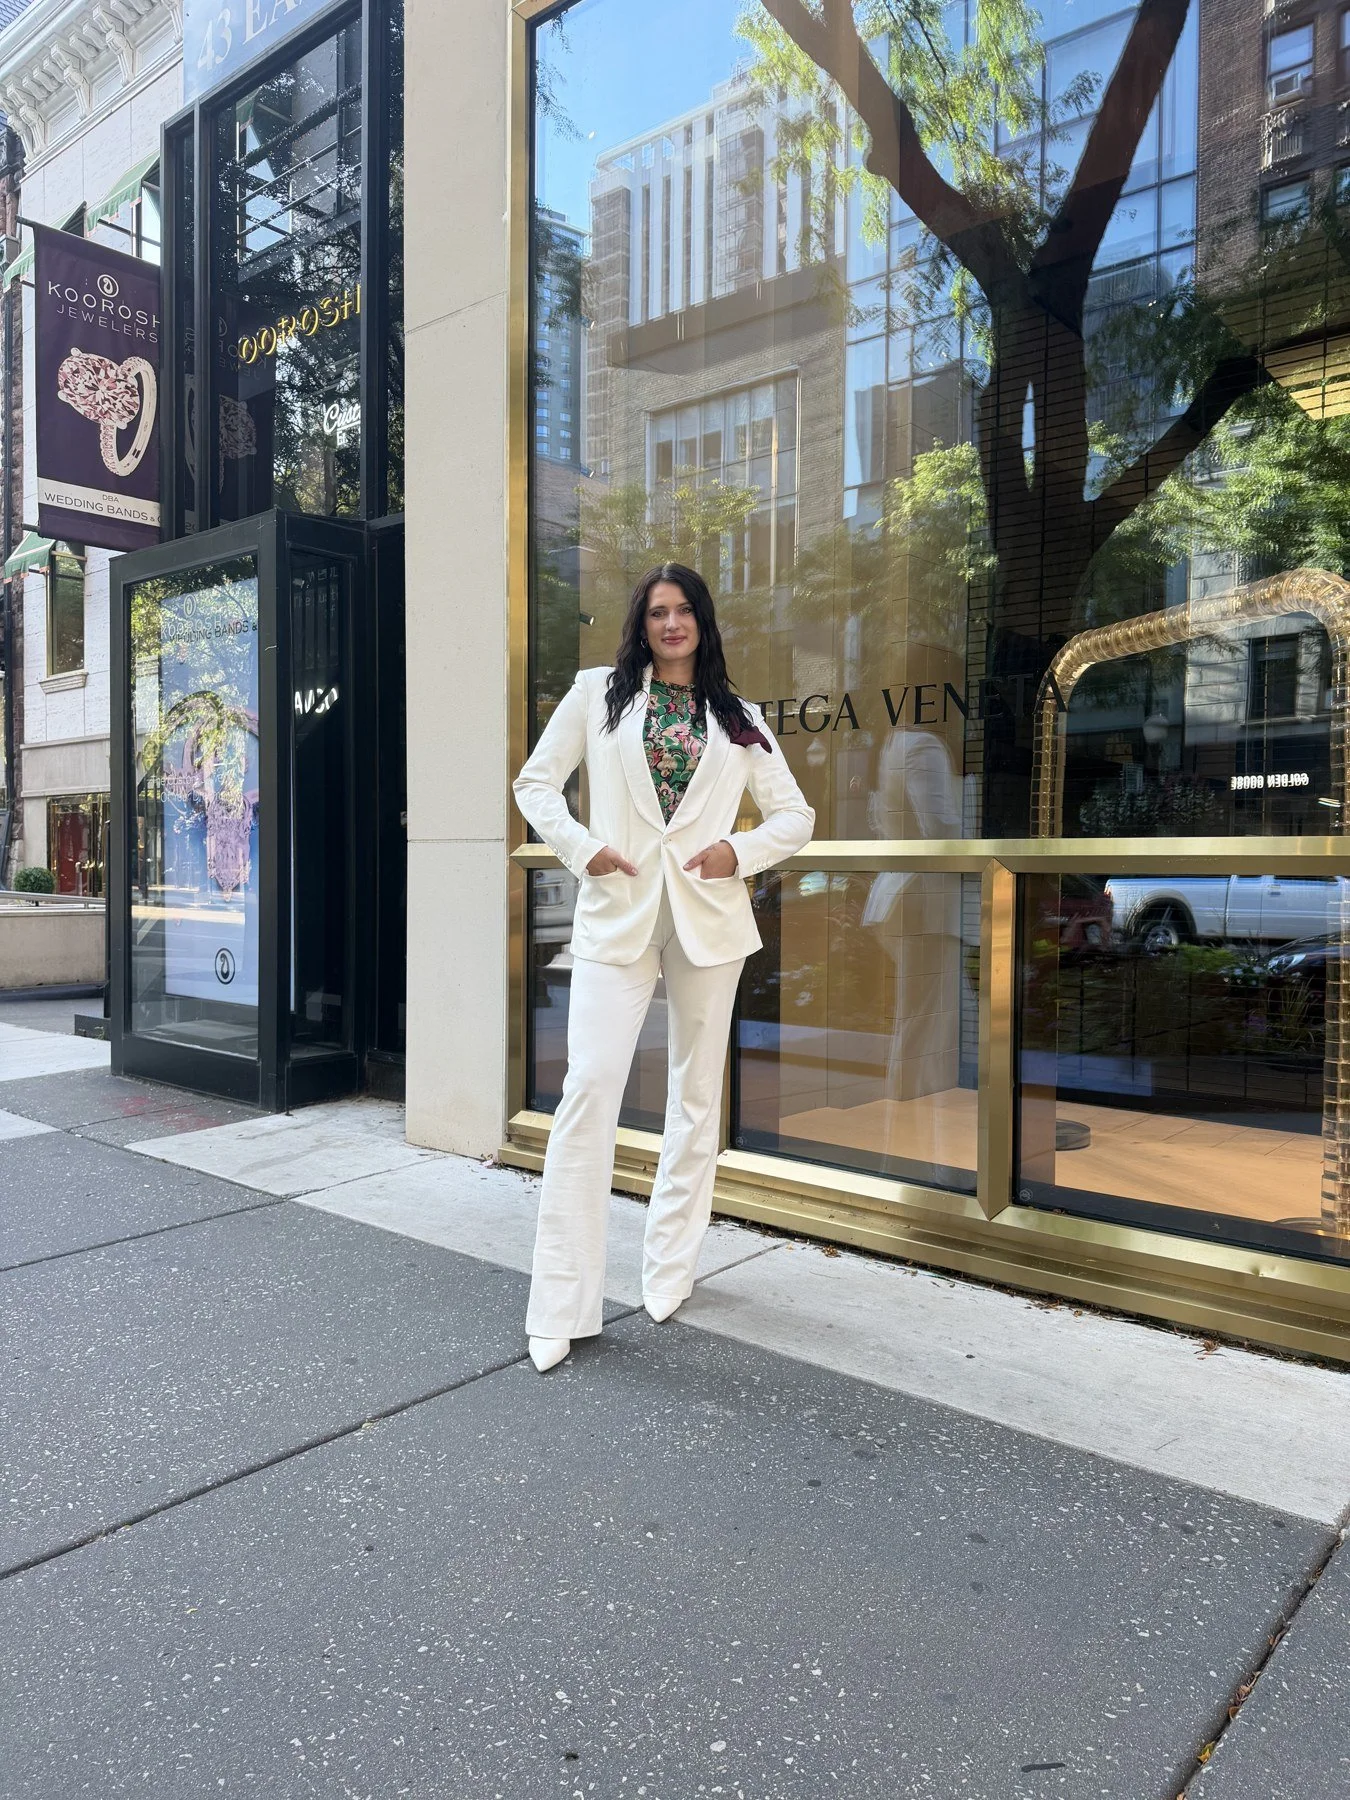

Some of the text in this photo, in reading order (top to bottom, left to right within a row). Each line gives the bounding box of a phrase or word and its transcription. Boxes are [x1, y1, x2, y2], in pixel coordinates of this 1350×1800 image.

[197, 8, 232, 71] 43
[48, 281, 160, 328] KOOROSH
[57, 304, 158, 343] JEWELERS
[45, 492, 104, 512] WEDDING
[107, 505, 148, 521] BANDS
[102, 494, 119, 503] DBA
[215, 620, 249, 638] BANDS
[881, 669, 1068, 727] VENETA
